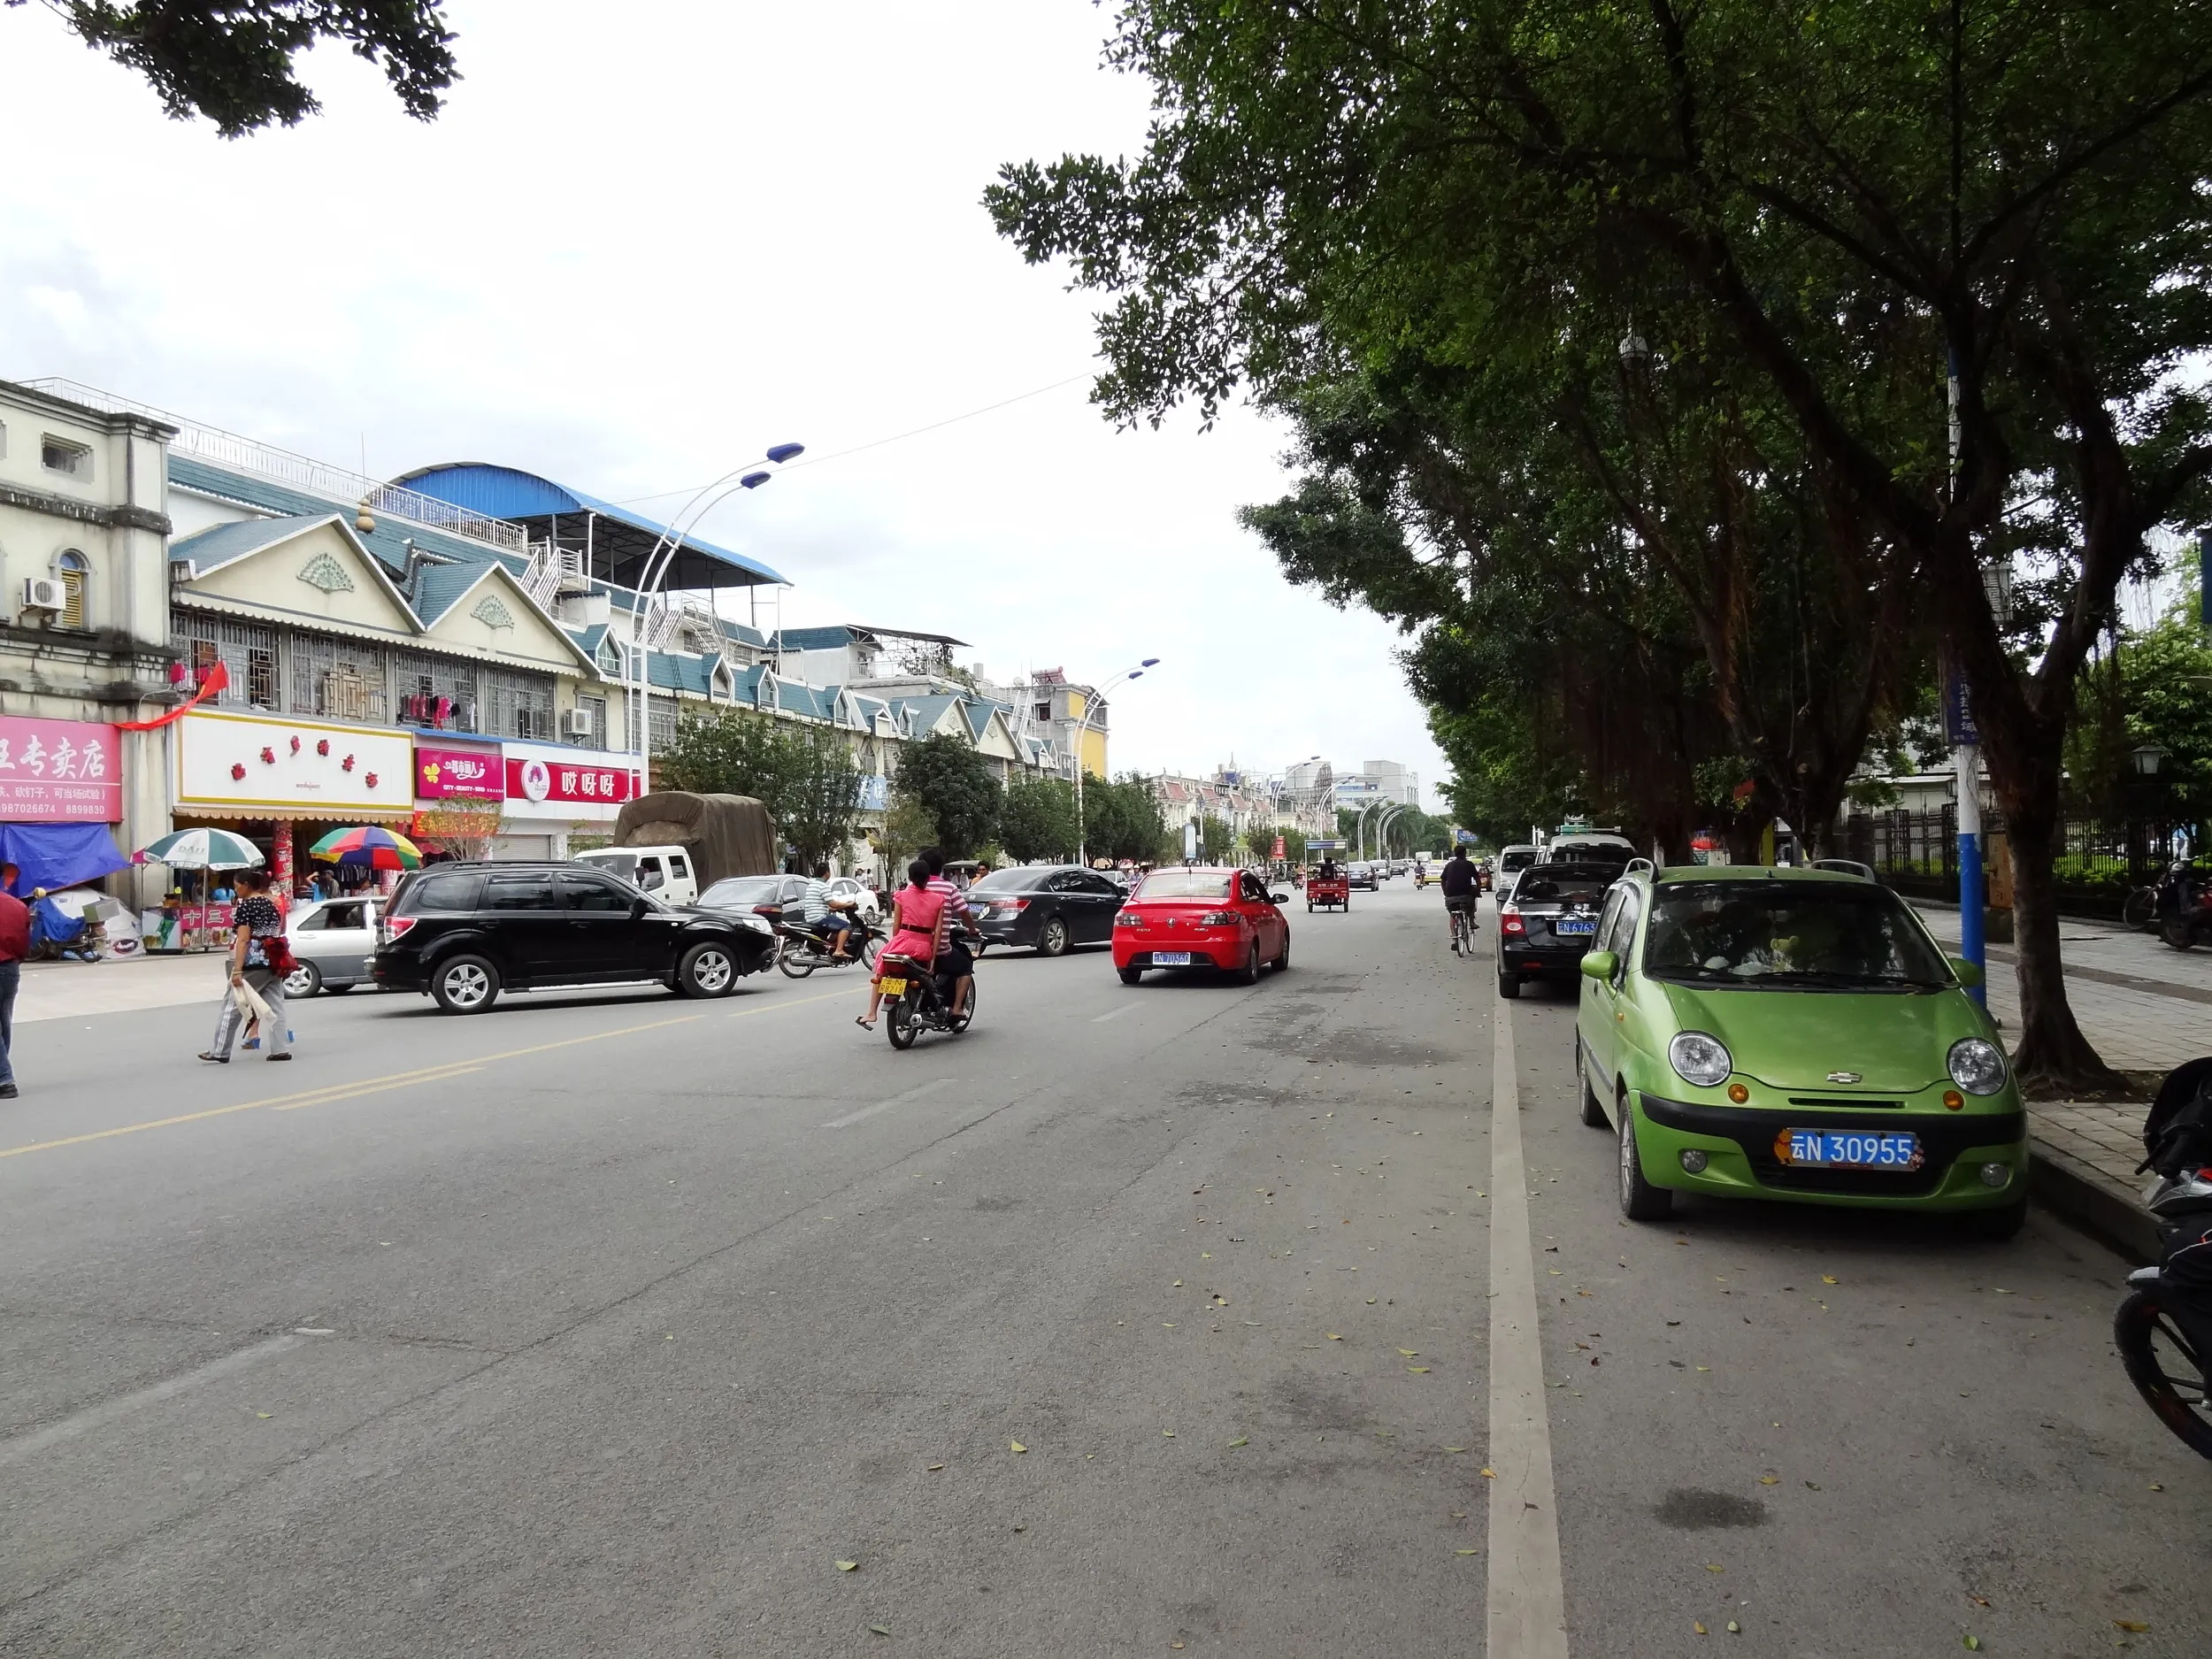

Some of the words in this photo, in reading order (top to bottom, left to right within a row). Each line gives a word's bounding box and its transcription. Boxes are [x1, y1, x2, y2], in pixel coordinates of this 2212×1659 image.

[562, 772, 615, 796] 哎呀呀
[0, 803, 56, 813] 987026674
[65, 805, 104, 814] 8899830
[1831, 1137, 1912, 1164] 30955
